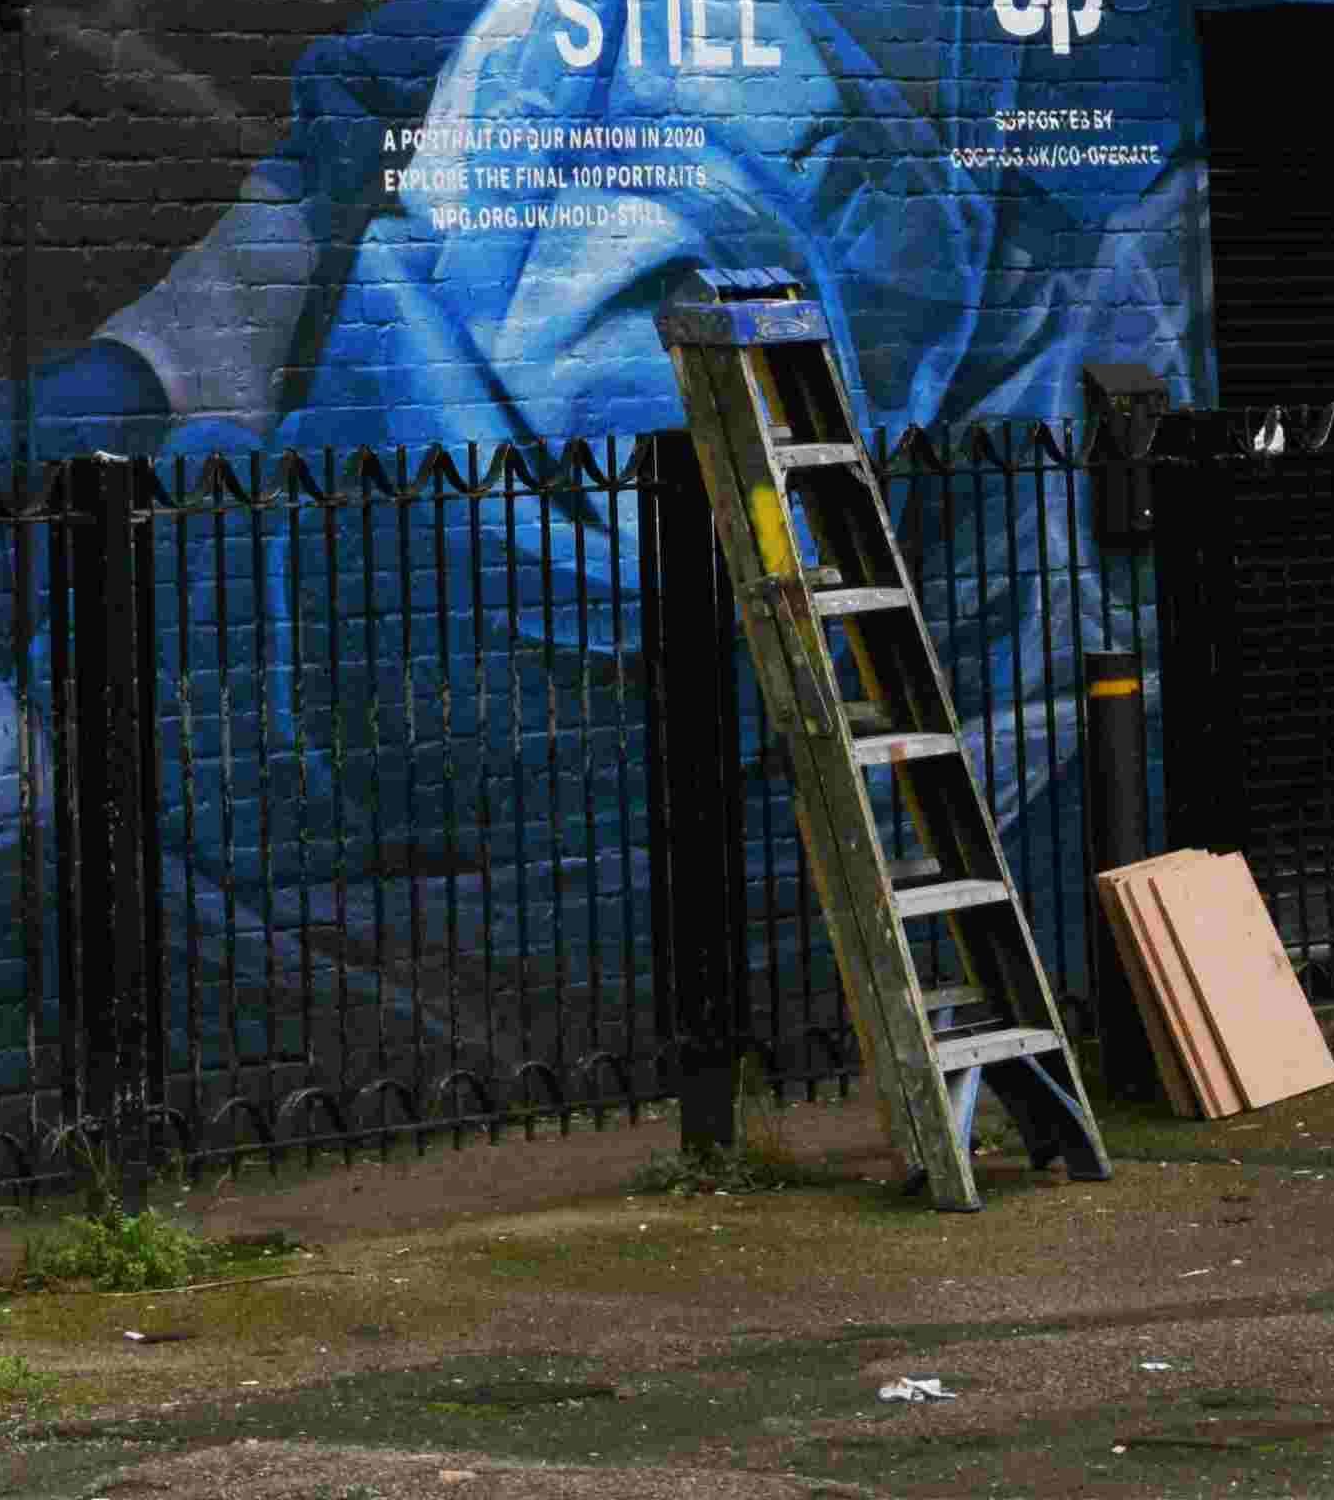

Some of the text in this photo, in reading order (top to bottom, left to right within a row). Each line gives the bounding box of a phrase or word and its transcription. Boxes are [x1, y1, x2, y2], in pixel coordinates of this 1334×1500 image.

[1093, 108, 1114, 129] BY
[383, 126, 706, 152] A PORTRAIT OF OUR NATION IN 2020
[384, 164, 707, 192] EXPLORE THE FINAL 100 PORTRAITS
